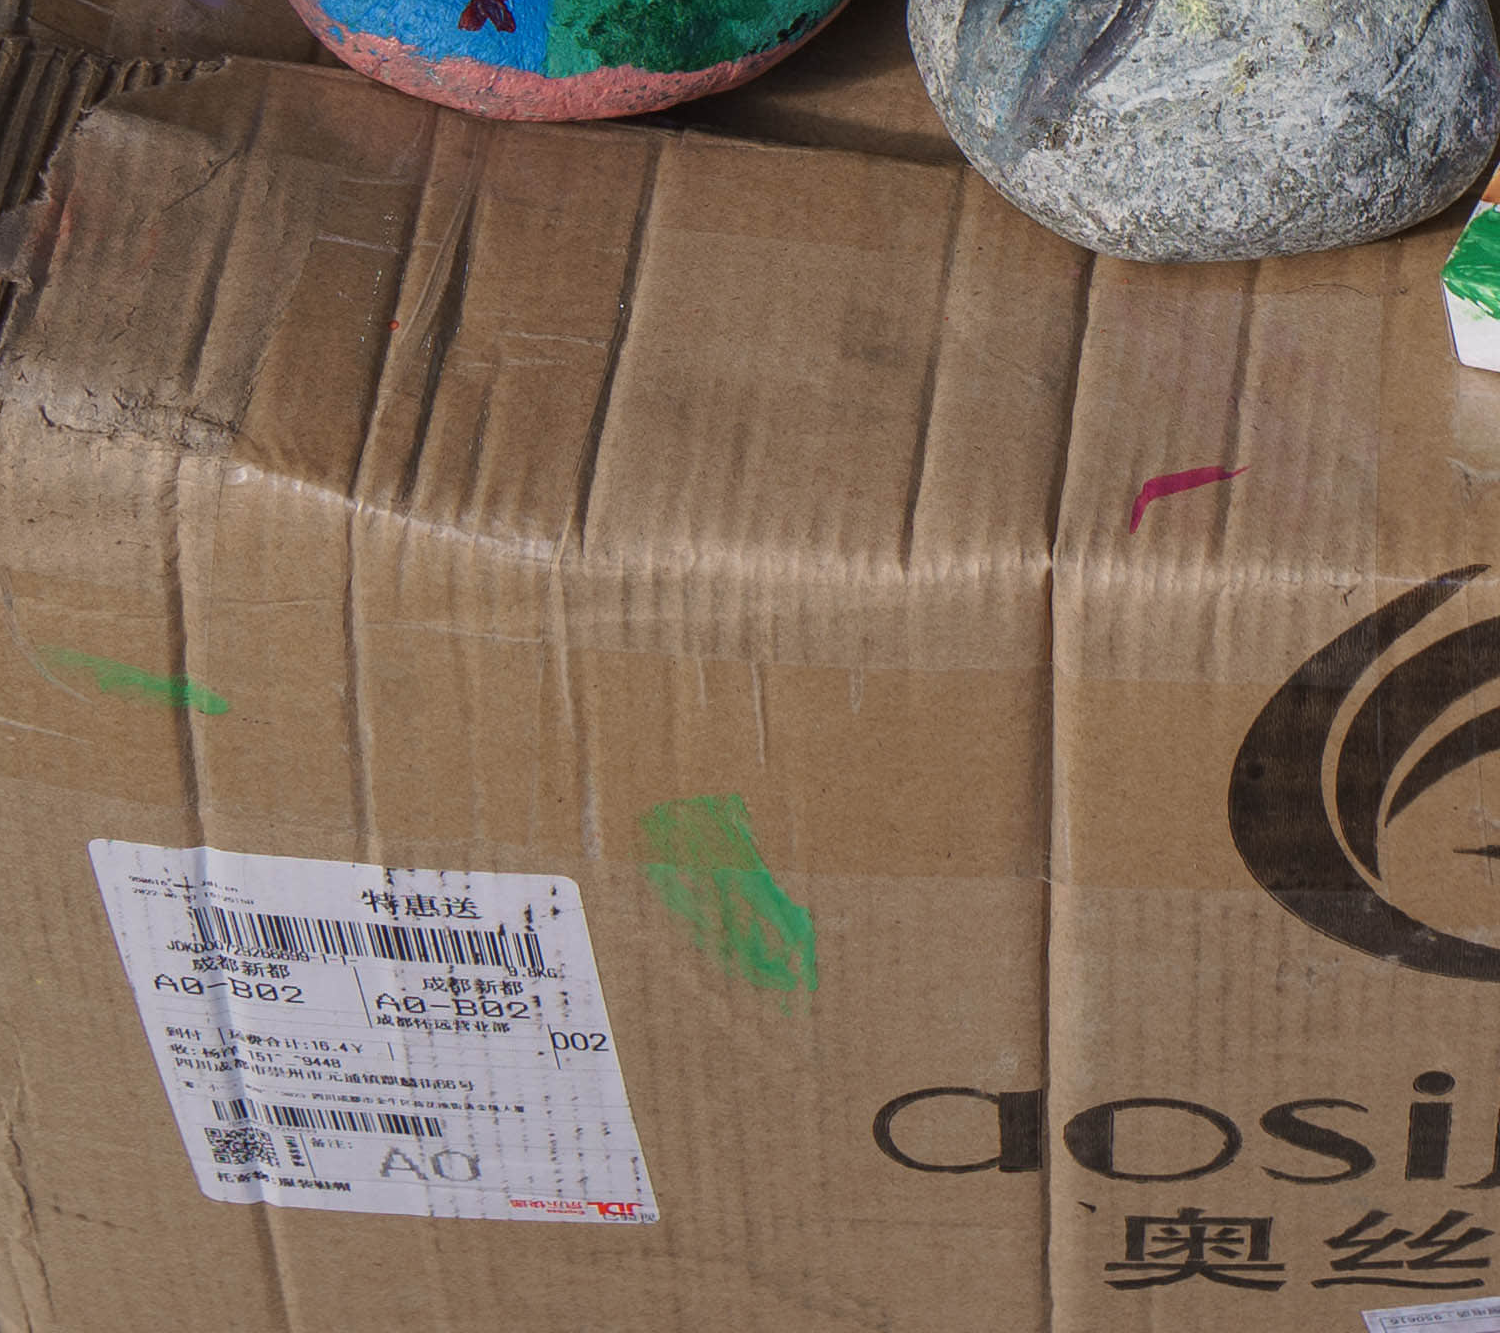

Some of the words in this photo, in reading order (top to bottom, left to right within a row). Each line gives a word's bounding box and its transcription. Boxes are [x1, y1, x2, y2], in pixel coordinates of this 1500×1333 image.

[361, 889, 483, 920] 特惠送
[192, 956, 290, 979] 成都新都
[153, 973, 306, 1004] A0-B02
[422, 976, 524, 996] 成都新都
[375, 992, 532, 1019] A0-B02
[551, 1032, 610, 1052] 002
[587, 1201, 645, 1217] JDL
